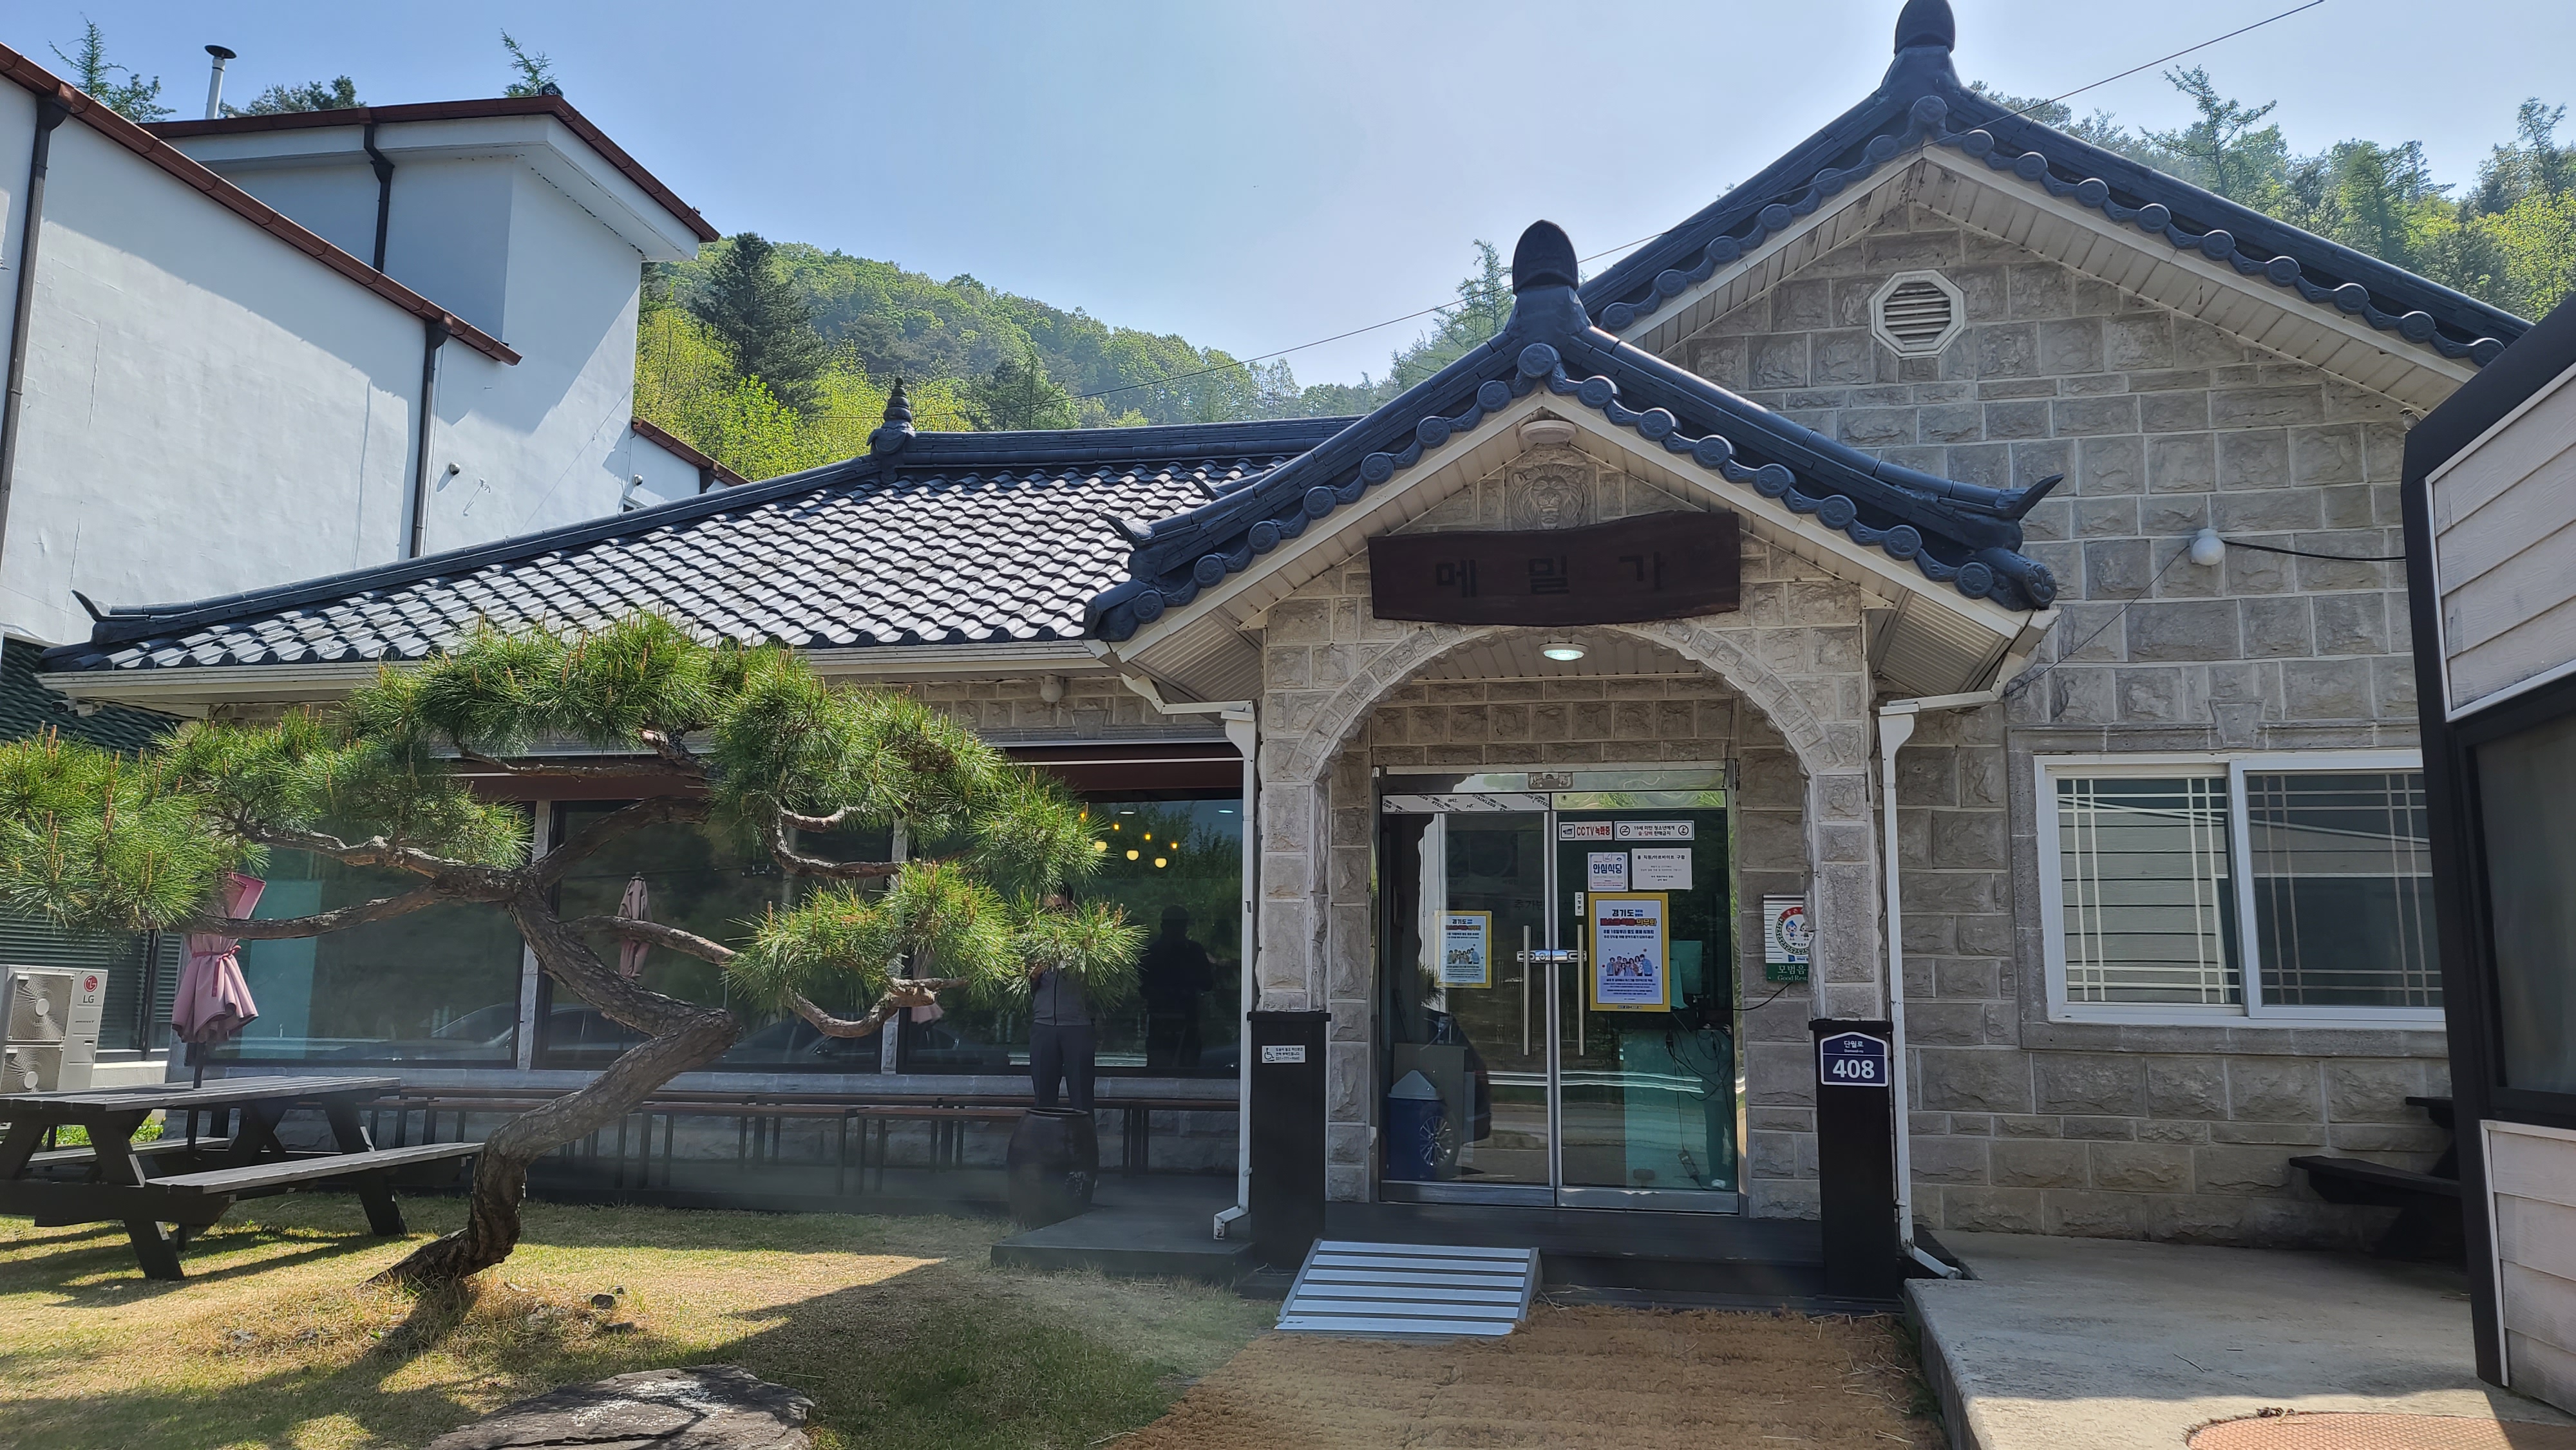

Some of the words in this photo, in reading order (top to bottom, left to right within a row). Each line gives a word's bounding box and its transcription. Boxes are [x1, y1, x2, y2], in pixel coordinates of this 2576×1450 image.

[1472, 794, 1497, 808] STAINLESS
[1593, 863, 1623, 874] 안심식당
[1636, 918, 1657, 927] 의무화
[1777, 965, 1809, 975] 모범음
[82, 995, 95, 1004] LG
[1832, 1059, 1875, 1079] 408
